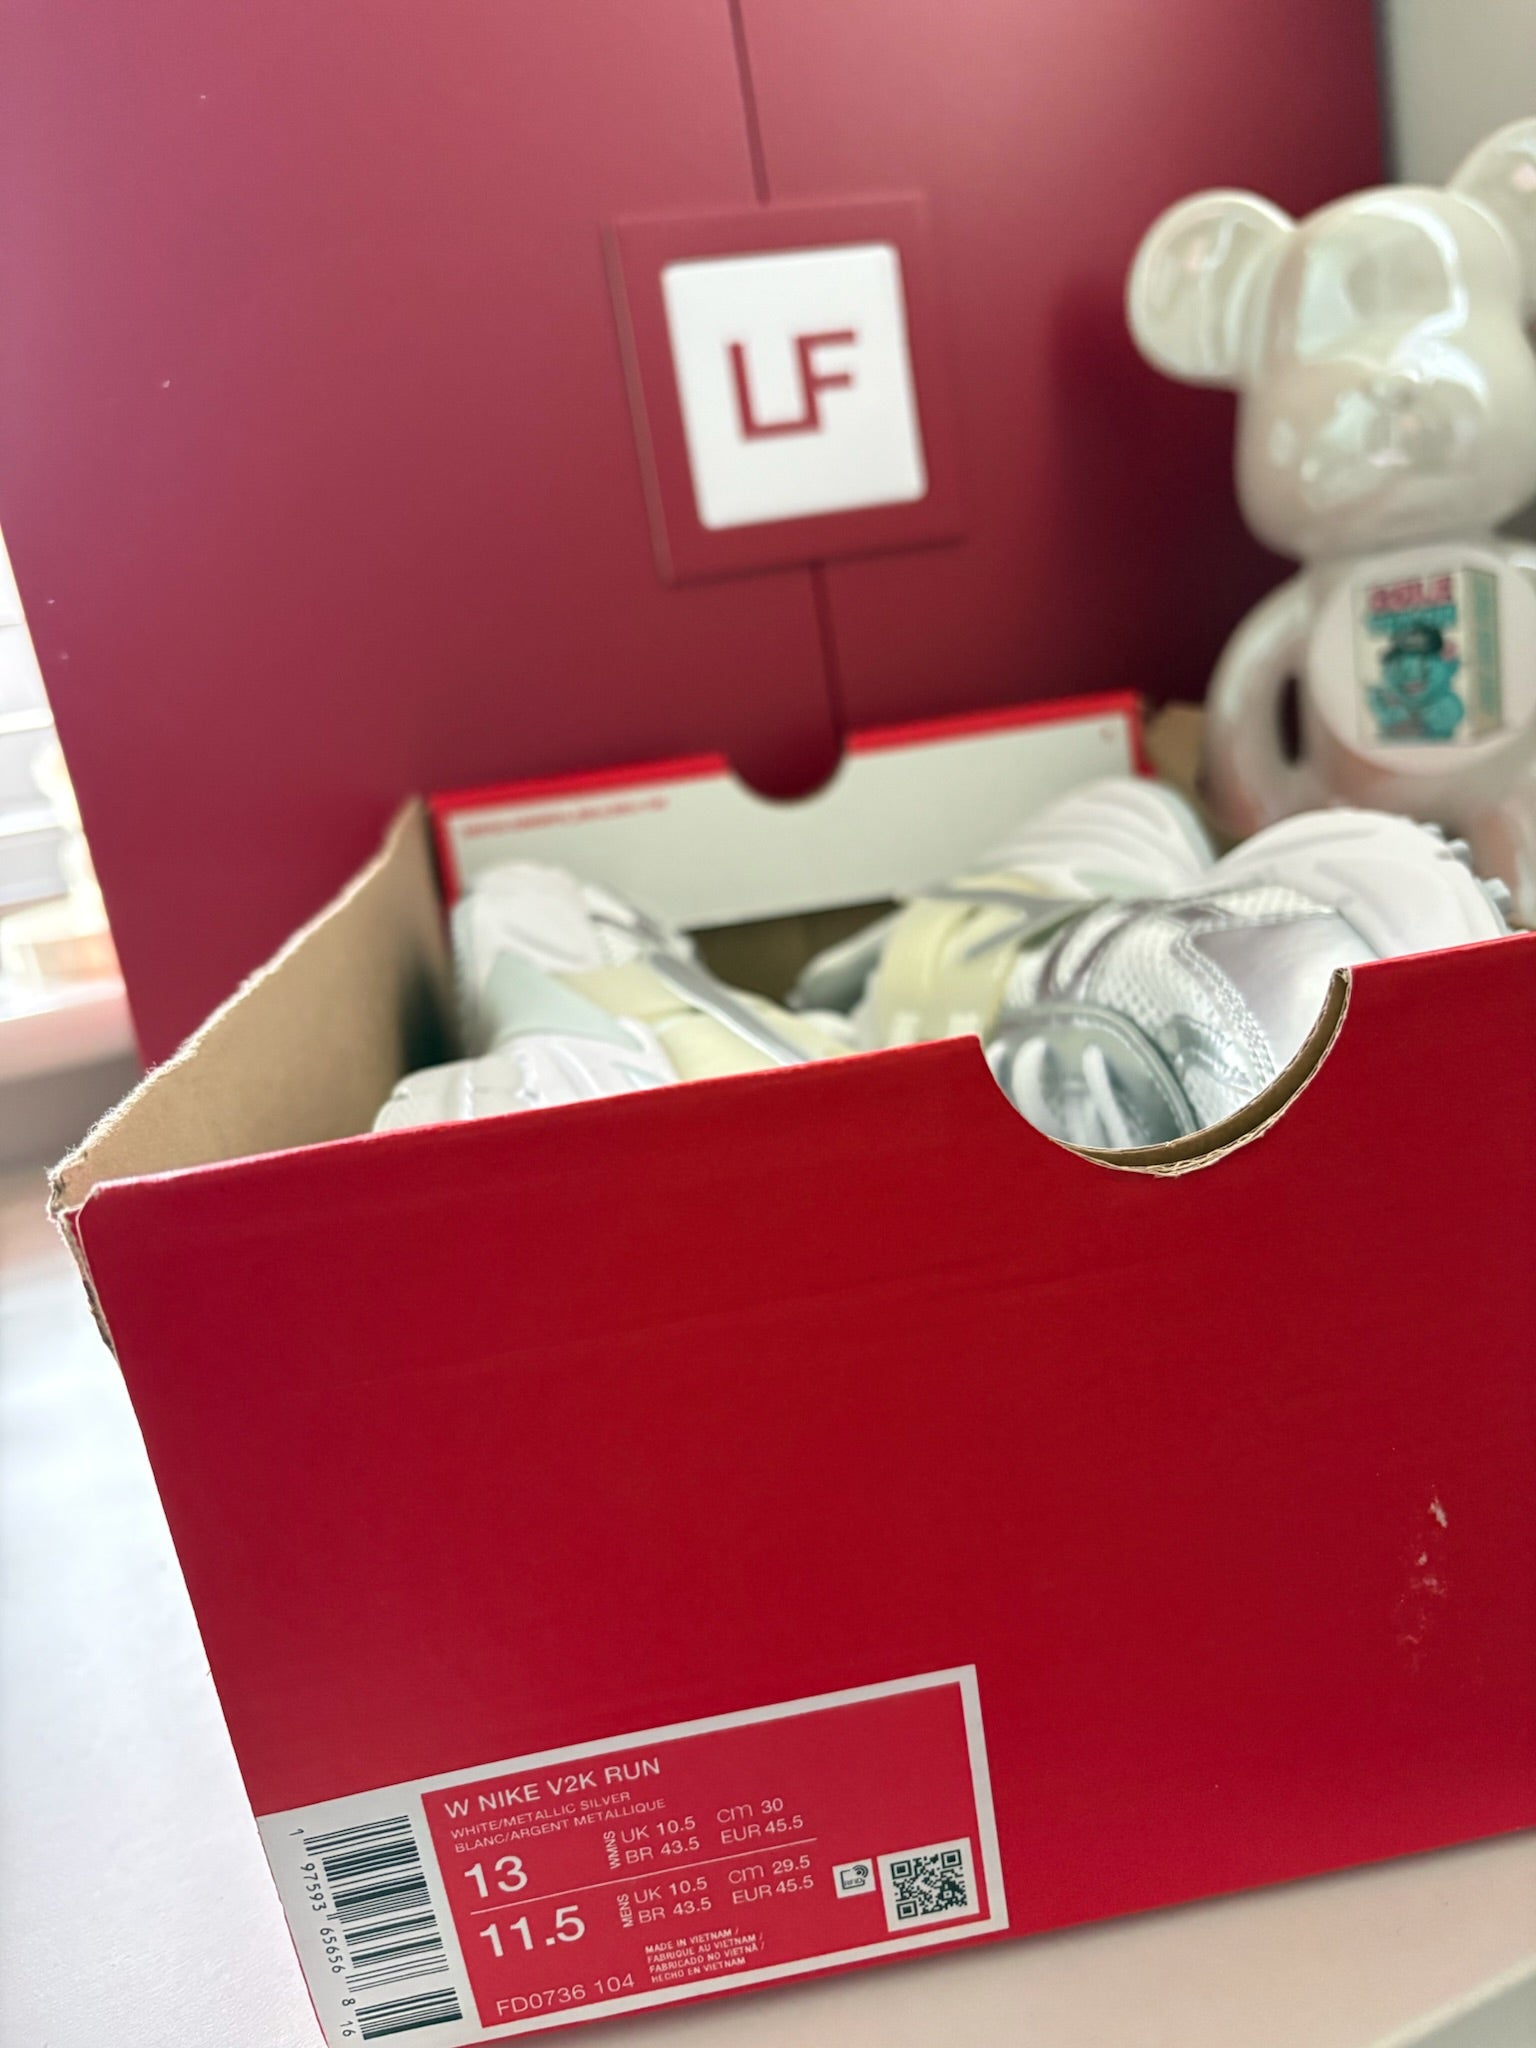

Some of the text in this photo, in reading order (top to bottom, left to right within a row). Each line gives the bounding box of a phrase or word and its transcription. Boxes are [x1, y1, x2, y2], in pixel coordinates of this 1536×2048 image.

[727, 330, 856, 442] LF
[444, 1757, 661, 1819] W NIKE V2K RUN
[450, 1791, 631, 1839] WHITE/METALLIC SILVER
[760, 1798, 784, 1815] 30
[289, 1828, 305, 1837] 1
[455, 1798, 666, 1853] BLANC/ARGENT METALLIQUE
[620, 1816, 696, 1844] UK 10.5
[720, 1814, 804, 1844] EUR 45.5
[603, 1829, 621, 1870] WMNS
[625, 1836, 700, 1864] BR 43.5
[771, 1854, 811, 1875] 29.5
[300, 1862, 327, 1912] 97593
[464, 1855, 528, 1898] 13
[633, 1876, 708, 1904] UK 10.5
[731, 1874, 814, 1905] EUR 45.5
[617, 1893, 635, 1928] MENS
[638, 1896, 712, 1924] BR 43.5
[479, 1905, 586, 1957] 11.5
[644, 1940, 674, 1954] MADE
[676, 1938, 687, 1947] IN
[689, 1927, 732, 1945] VIETNAM
[320, 1926, 346, 1974] 65656
[647, 1946, 695, 1964] FABRIQUE
[697, 1943, 712, 1953] AU
[713, 1933, 757, 1949] VIETNAM
[648, 1954, 705, 1974] FABRICADO
[706, 1951, 722, 1961] NO
[651, 1956, 747, 1984] HECHO EN VIETNAM
[341, 1997, 356, 2008] 8
[495, 1972, 636, 2017] FD0736 104
[340, 2020, 356, 2037] 16
